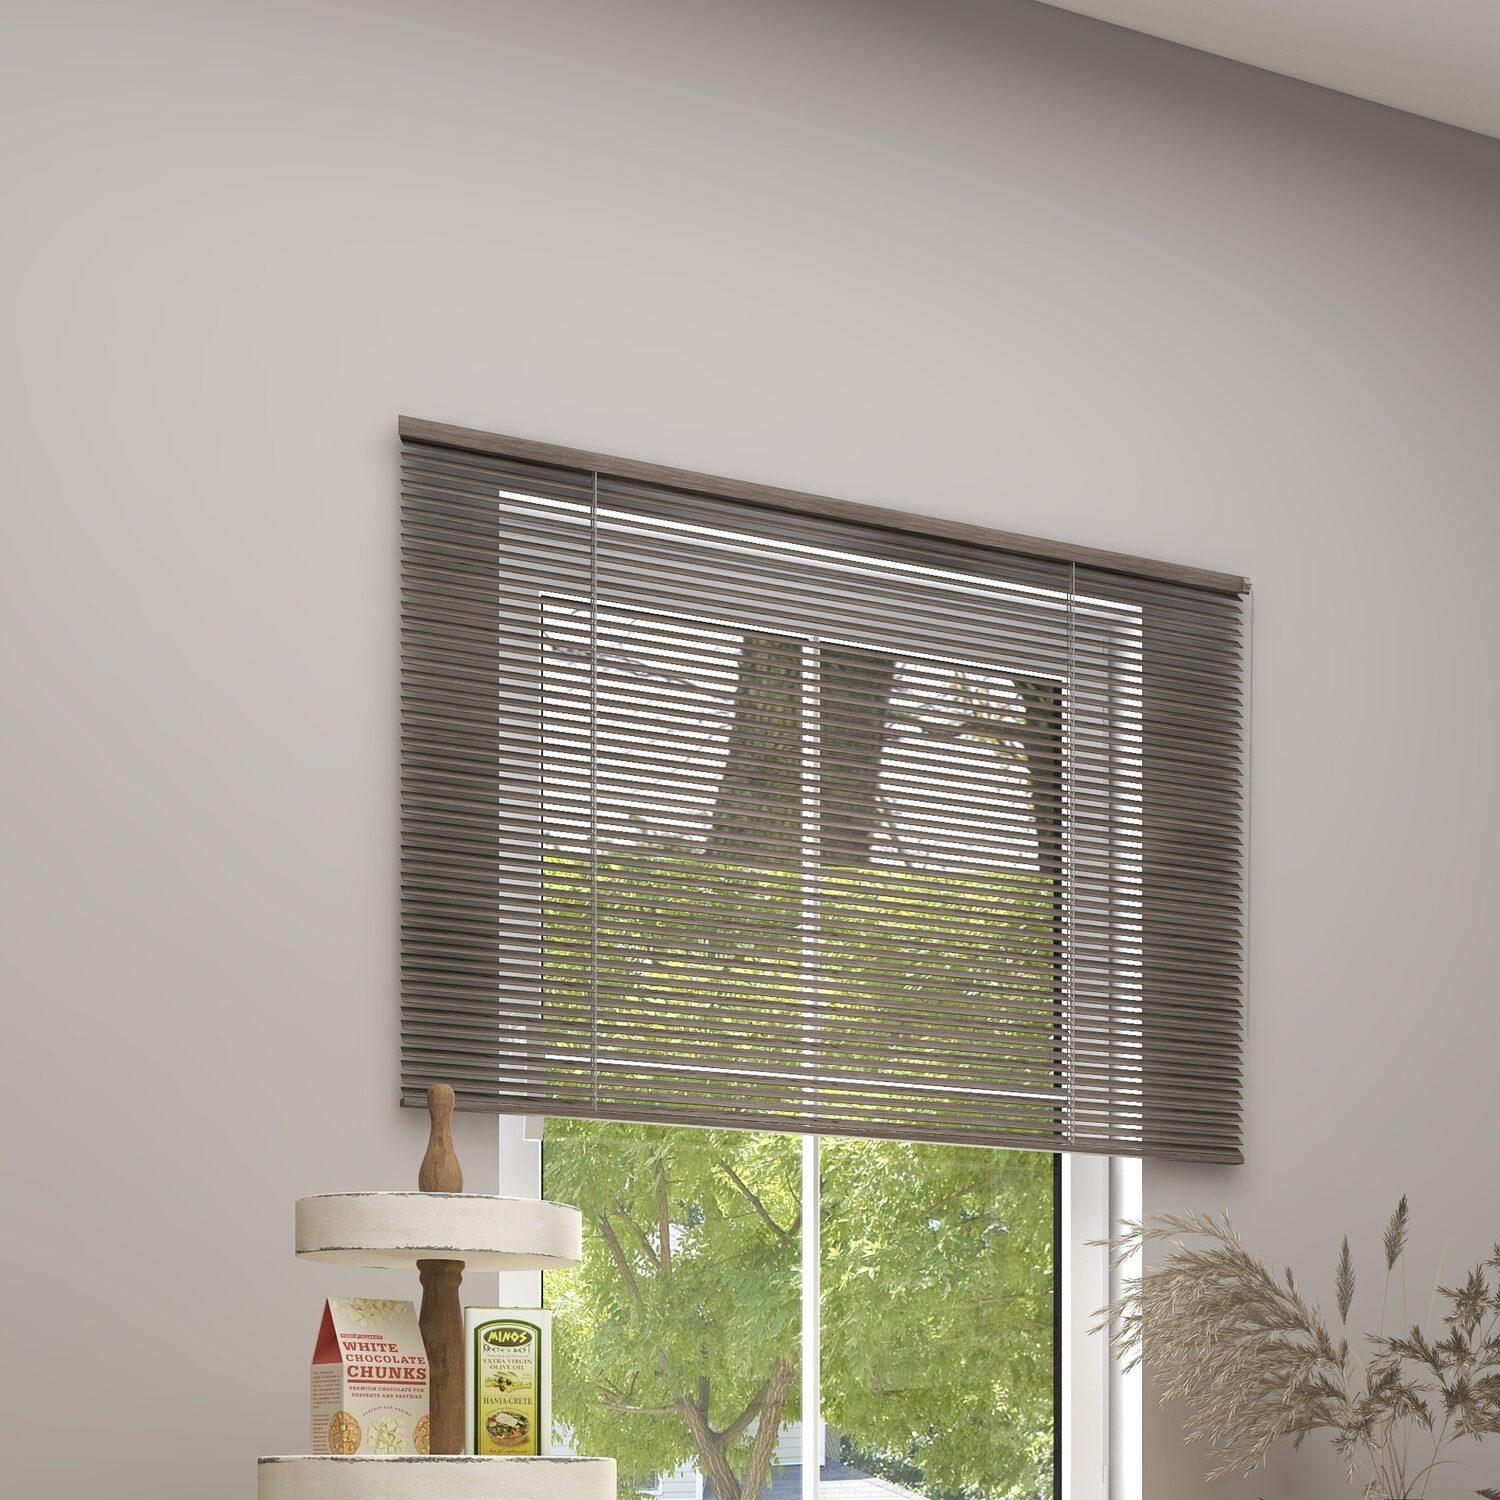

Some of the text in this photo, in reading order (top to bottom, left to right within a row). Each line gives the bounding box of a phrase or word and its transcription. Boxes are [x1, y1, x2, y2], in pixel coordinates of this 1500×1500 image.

[488, 1331, 527, 1343] MINOS
[342, 1341, 399, 1353] WHITE
[346, 1354, 426, 1365] CHOCOLATE
[347, 1365, 427, 1379] CHUNKS
